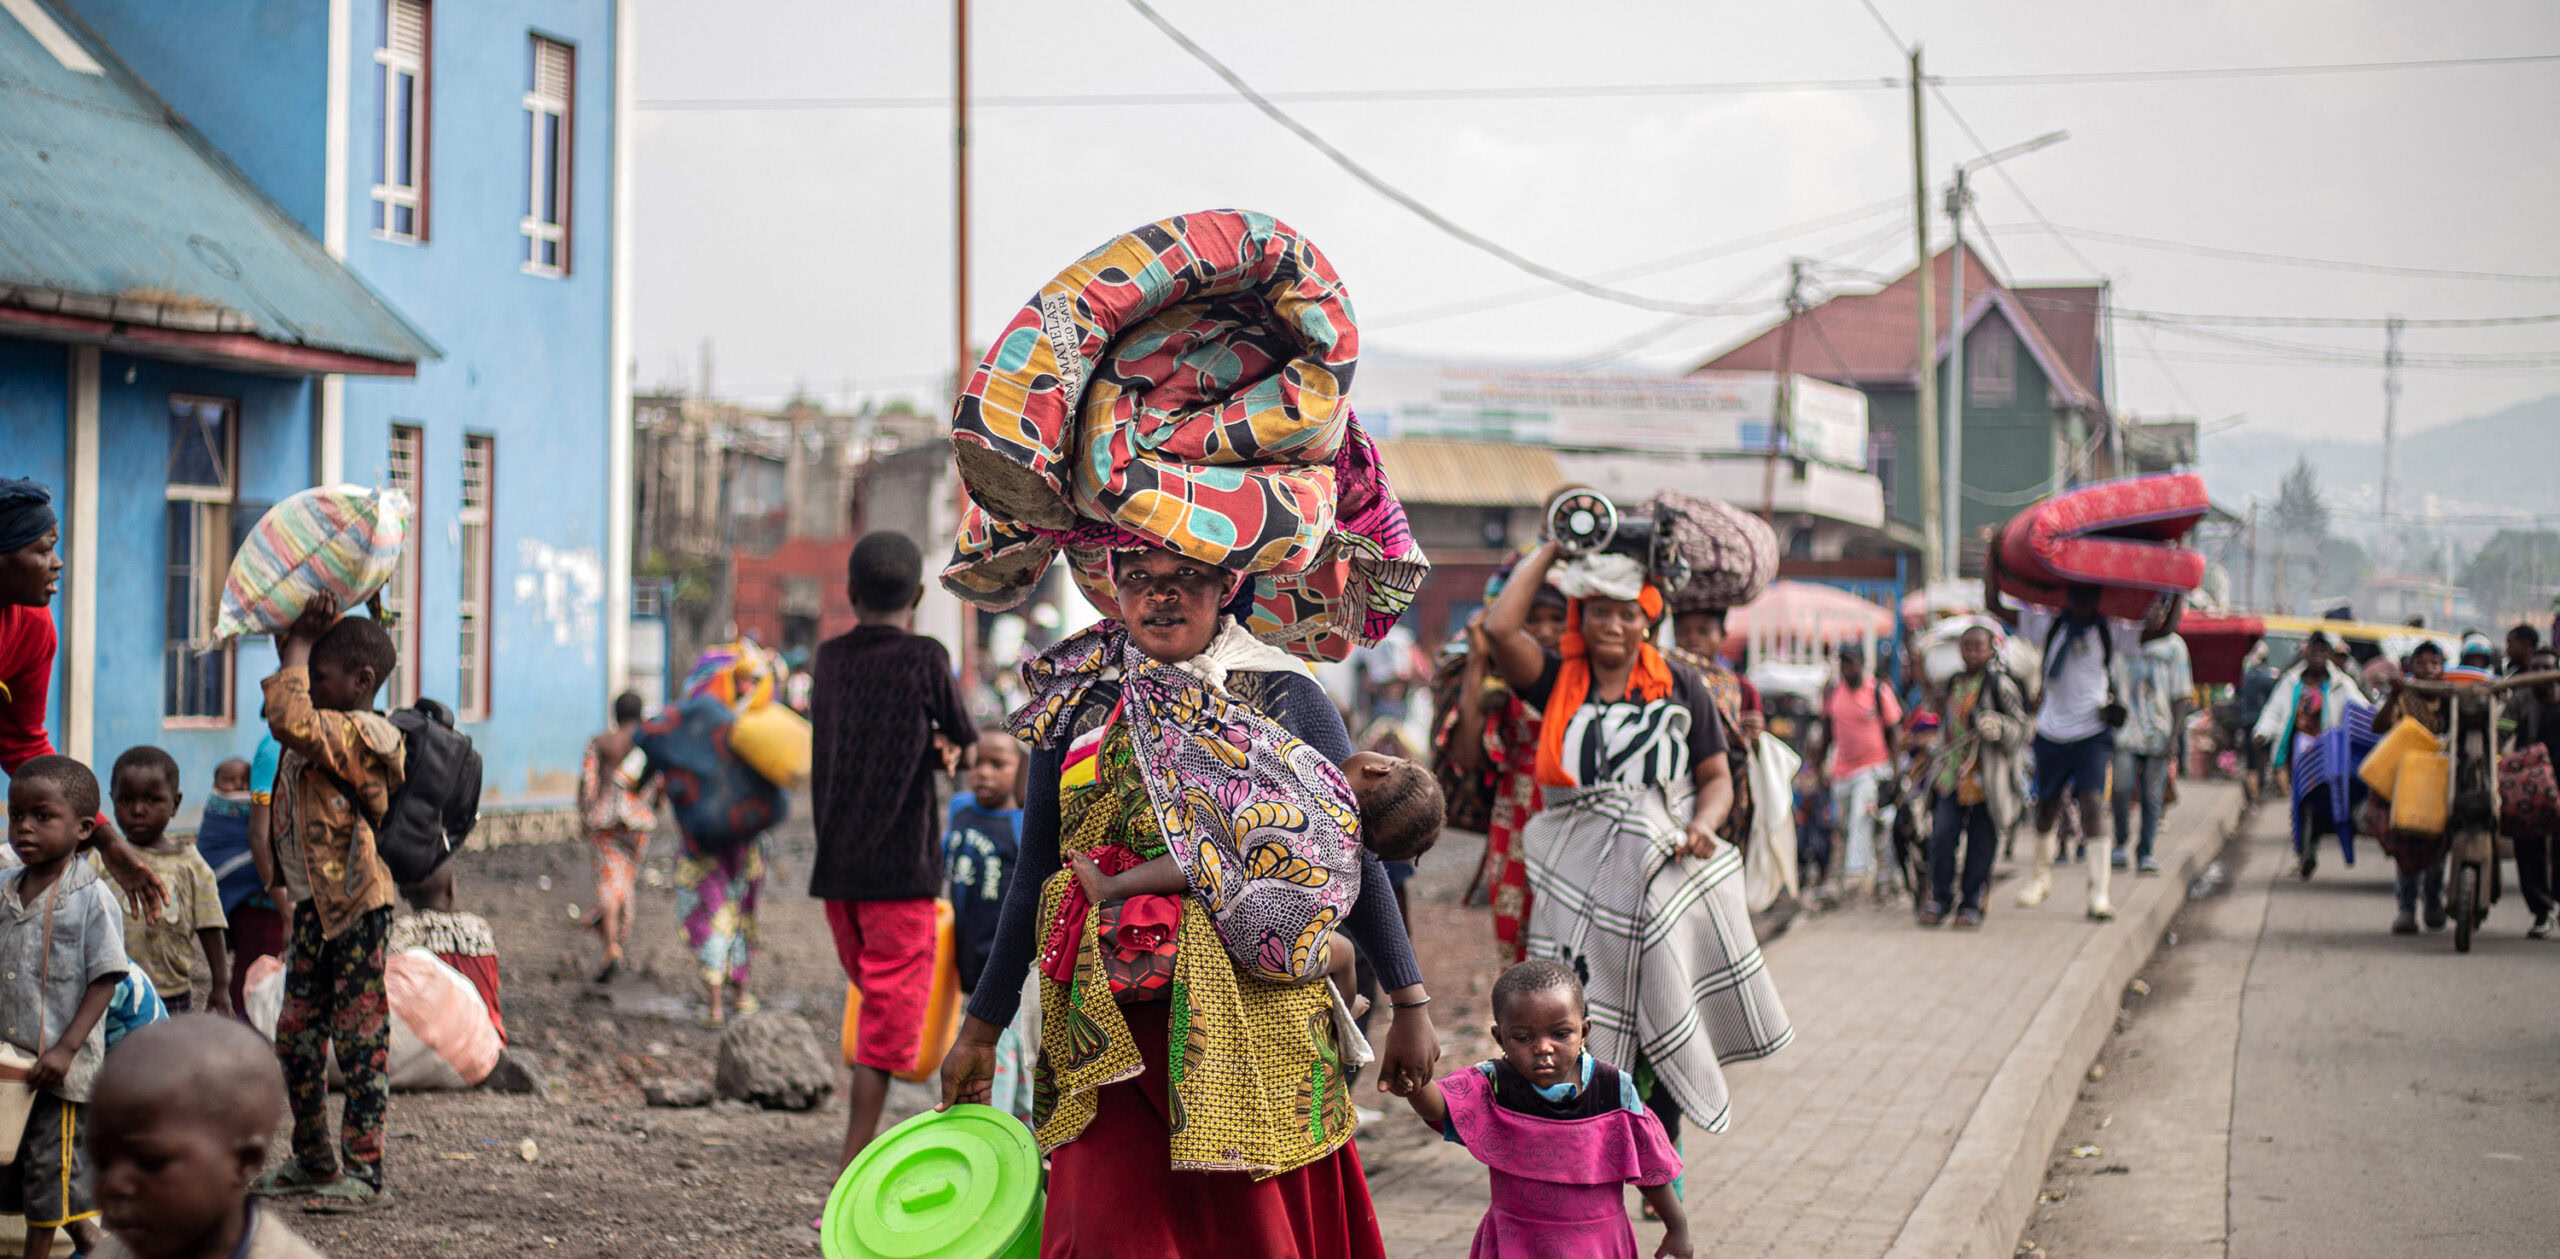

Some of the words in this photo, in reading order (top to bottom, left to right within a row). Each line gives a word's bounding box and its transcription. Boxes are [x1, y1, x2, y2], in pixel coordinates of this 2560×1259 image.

[1058, 293, 1071, 323] SARL
[1045, 301, 1071, 376] MATELAS
[1065, 328, 1079, 365] CONGO
